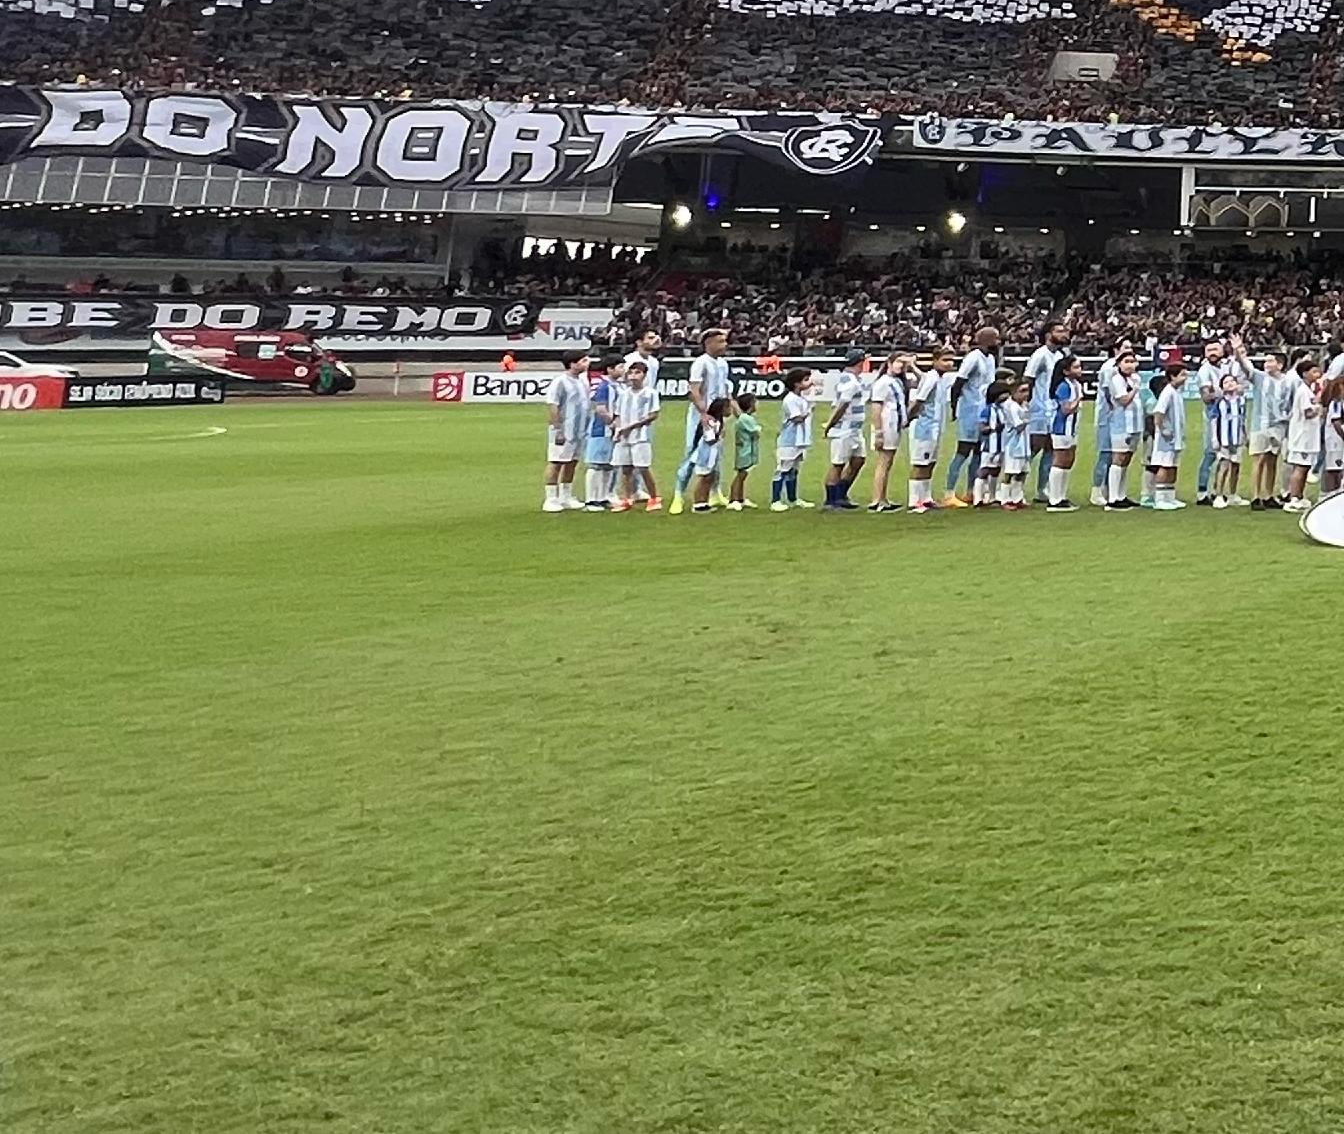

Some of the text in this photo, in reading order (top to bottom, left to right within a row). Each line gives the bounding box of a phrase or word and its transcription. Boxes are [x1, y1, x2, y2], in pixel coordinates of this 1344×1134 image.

[30, 89, 240, 156] DO
[149, 303, 260, 330] DO
[284, 304, 492, 332] REMO
[554, 327, 592, 341] PAR
[737, 379, 787, 397] ZERO
